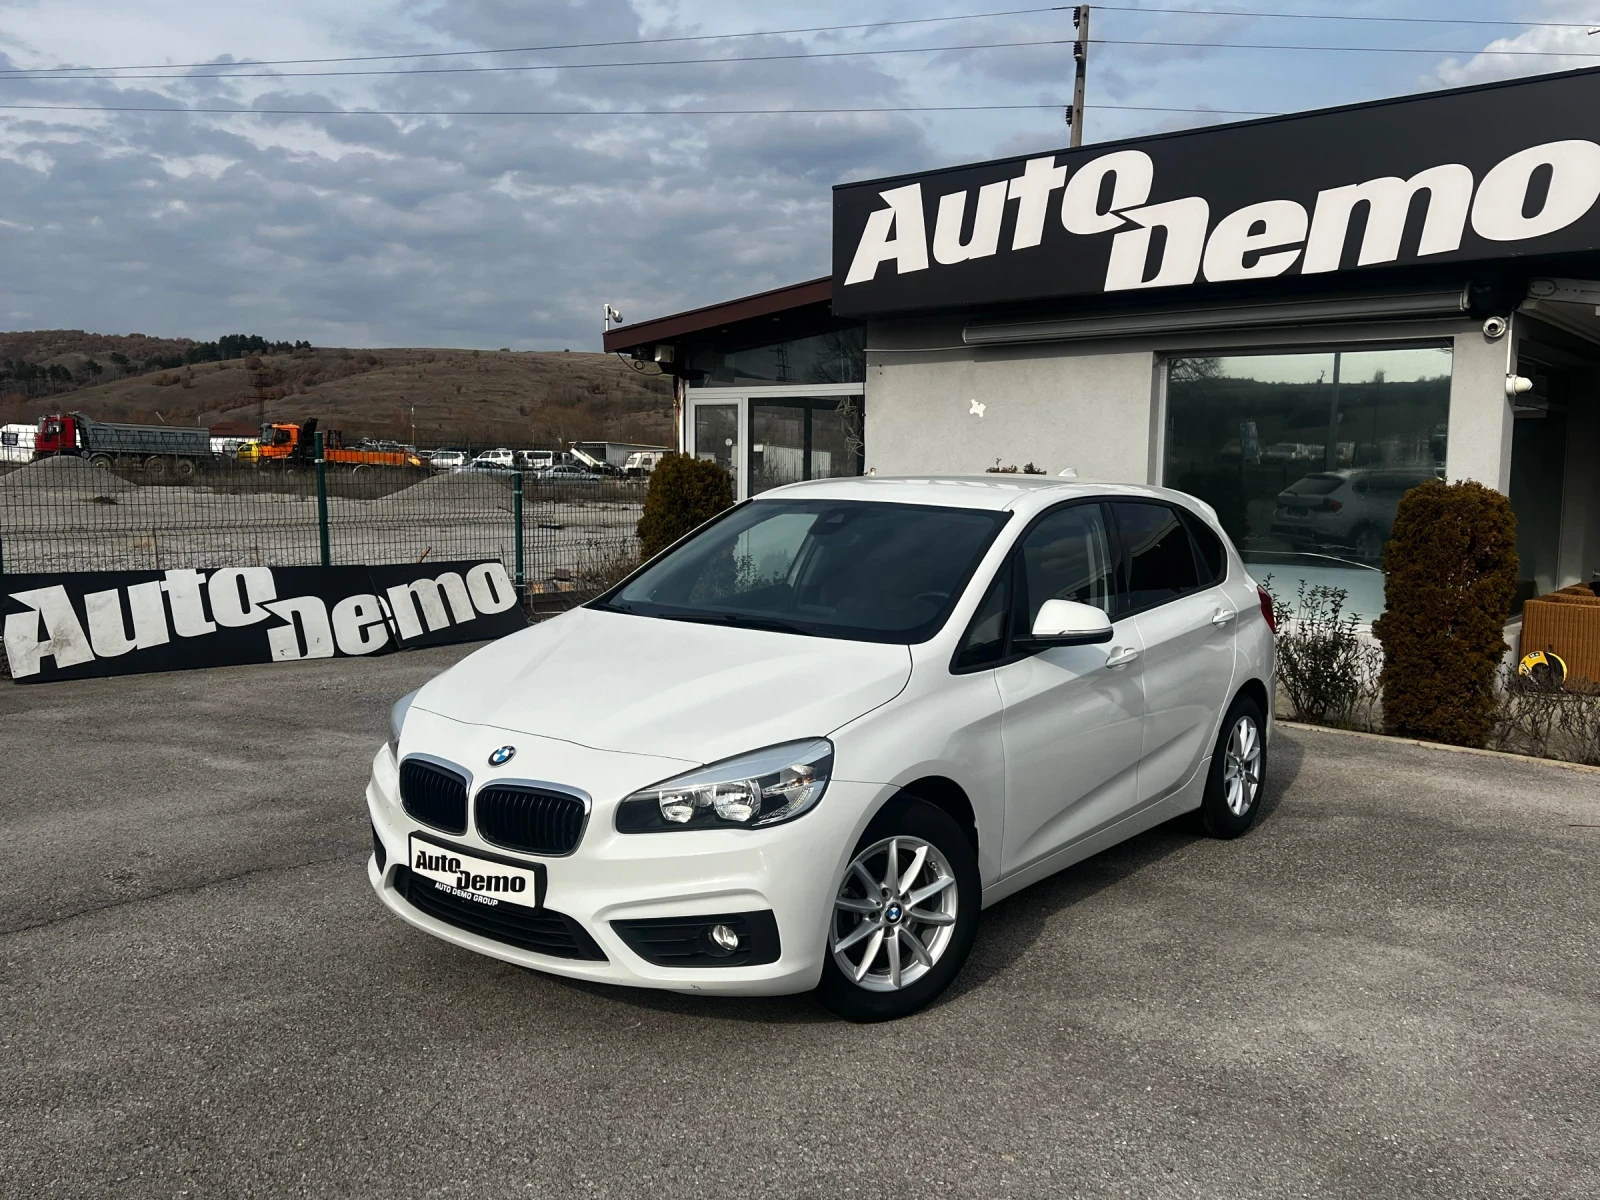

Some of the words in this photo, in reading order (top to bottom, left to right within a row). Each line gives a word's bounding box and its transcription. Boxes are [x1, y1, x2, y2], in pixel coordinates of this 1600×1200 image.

[844, 150, 1154, 285] Auto
[1104, 139, 1600, 291] Demo
[4, 566, 278, 679] Auto
[264, 562, 518, 662] Demo
[415, 850, 461, 873] Auto
[456, 870, 526, 893] Demo
[434, 881, 452, 893] AUTO
[452, 887, 472, 900] DEMO
[472, 894, 499, 906] GROUP
